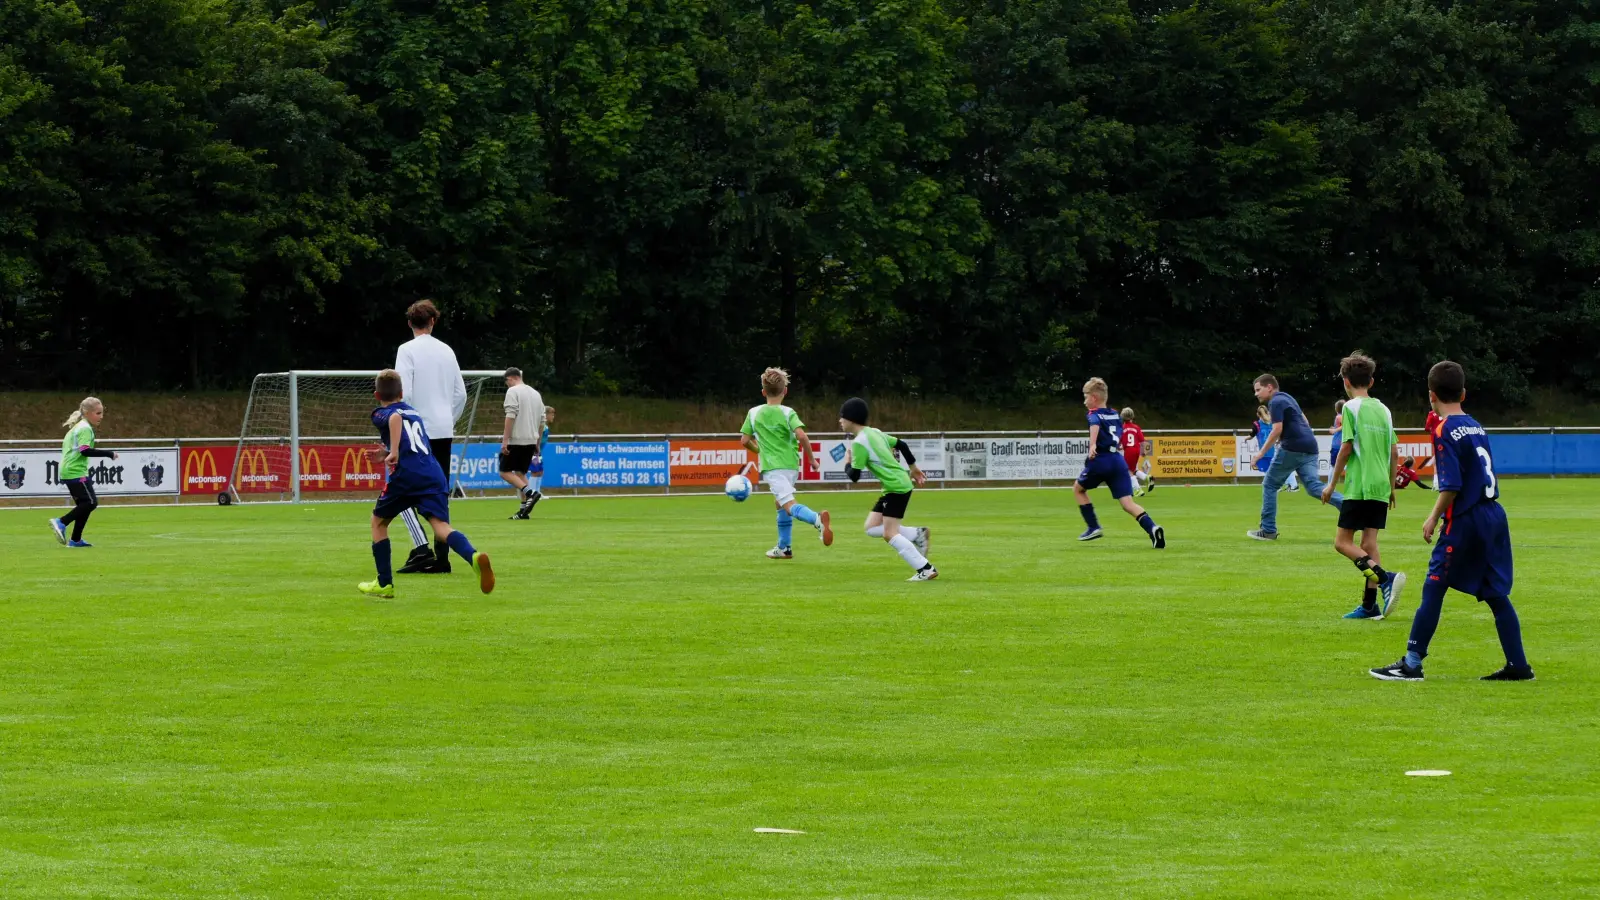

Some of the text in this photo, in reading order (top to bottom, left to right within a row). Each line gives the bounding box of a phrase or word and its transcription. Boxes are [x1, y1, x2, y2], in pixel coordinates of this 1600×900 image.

[1126, 433, 1135, 447] 9
[1158, 439, 1200, 448] Reparaturen
[556, 444, 665, 454] Ihr Partner in Schwarzenfeld:
[992, 441, 1013, 456] Gradl
[1066, 440, 1090, 454] GmbH
[670, 447, 747, 466] zitzmann
[581, 457, 665, 469] Stefan Harmsen
[1157, 458, 1211, 467] Sauerzapfstraße
[1185, 467, 1213, 475] Nabburg
[1476, 446, 1496, 498] 3
[188, 475, 227, 483] McDonald's
[241, 474, 279, 482] McDonald's
[298, 473, 331, 481] cDonald's
[586, 472, 618, 484] 09435
[621, 472, 634, 484] 50
[636, 472, 650, 484] 28
[652, 472, 665, 484] 16
